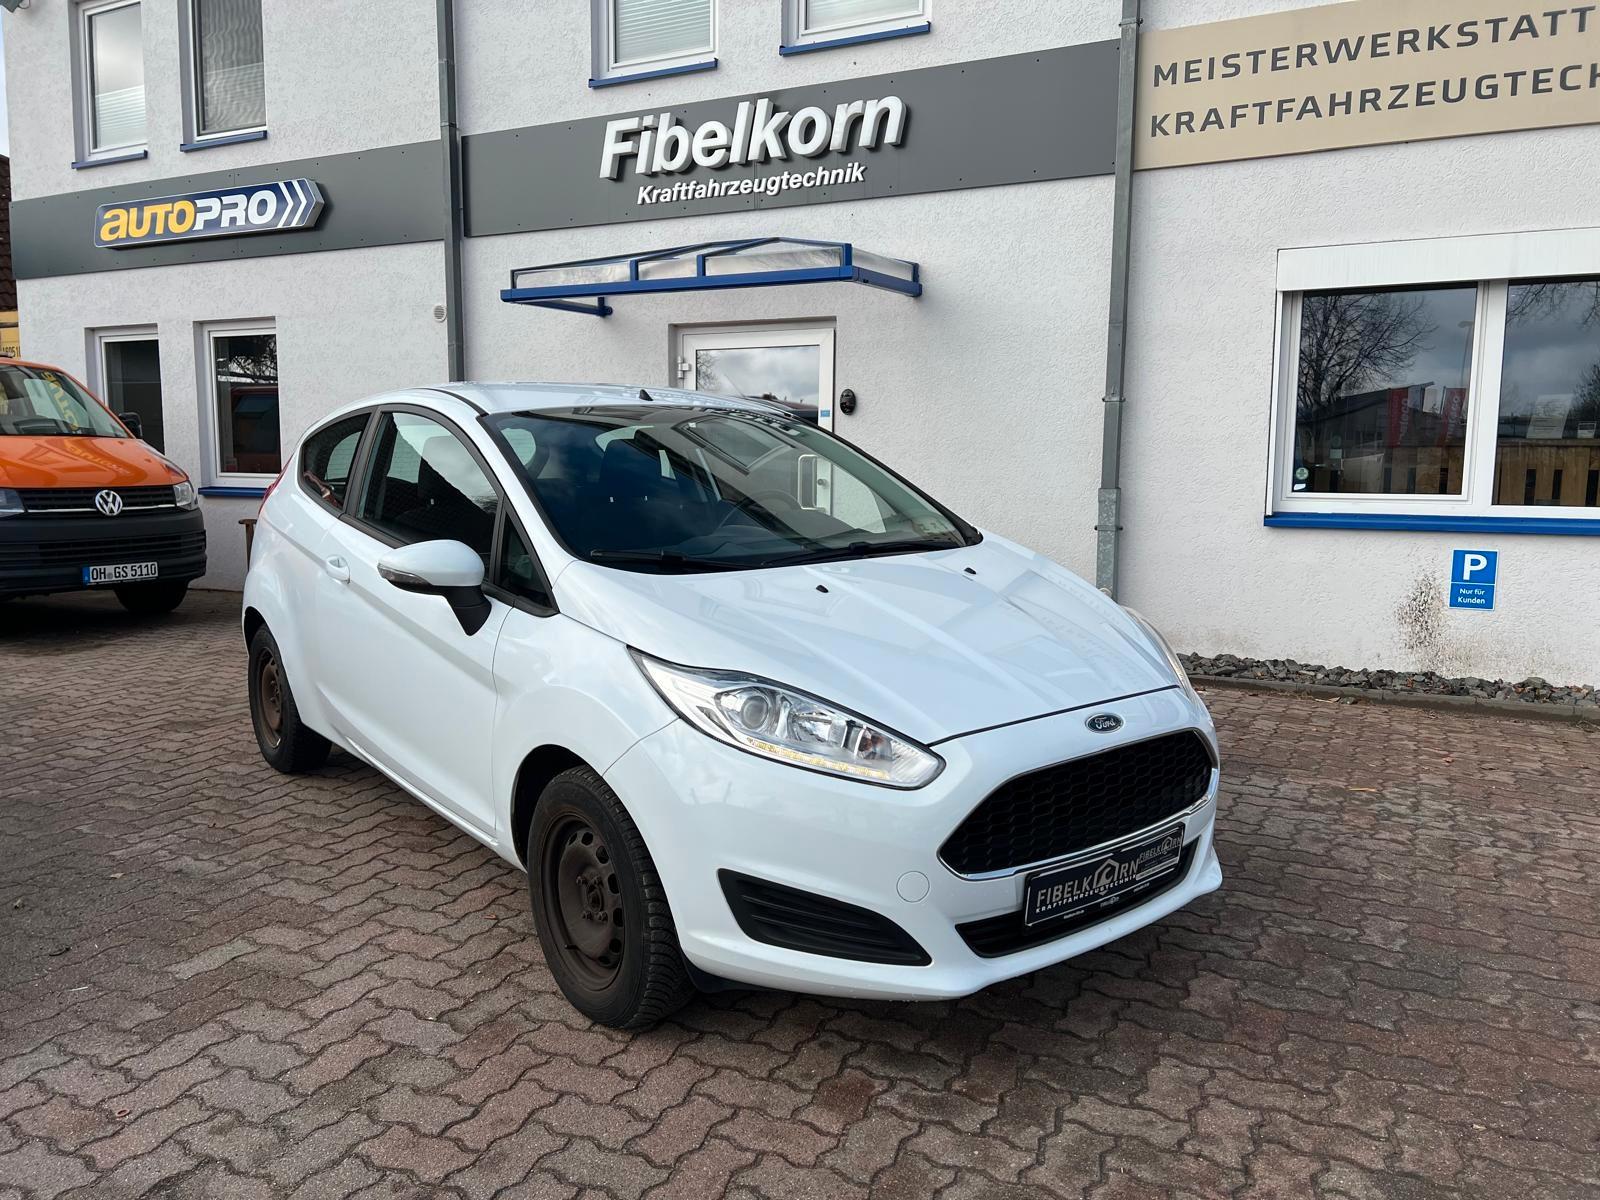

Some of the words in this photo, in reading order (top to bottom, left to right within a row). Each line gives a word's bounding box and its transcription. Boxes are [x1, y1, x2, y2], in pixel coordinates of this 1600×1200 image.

[1153, 5, 1596, 87] MEISTERWERKSTATT
[599, 95, 906, 179] Fibelkorn
[637, 162, 866, 205] Kraftfahrzeugtechnik
[91, 567, 107, 581] OH
[113, 565, 128, 579] GS
[130, 563, 157, 577] 5110
[1463, 553, 1488, 581] P
[1457, 596, 1486, 604] Kunden
[1474, 588, 1486, 596] für
[1094, 716, 1116, 730] Ford
